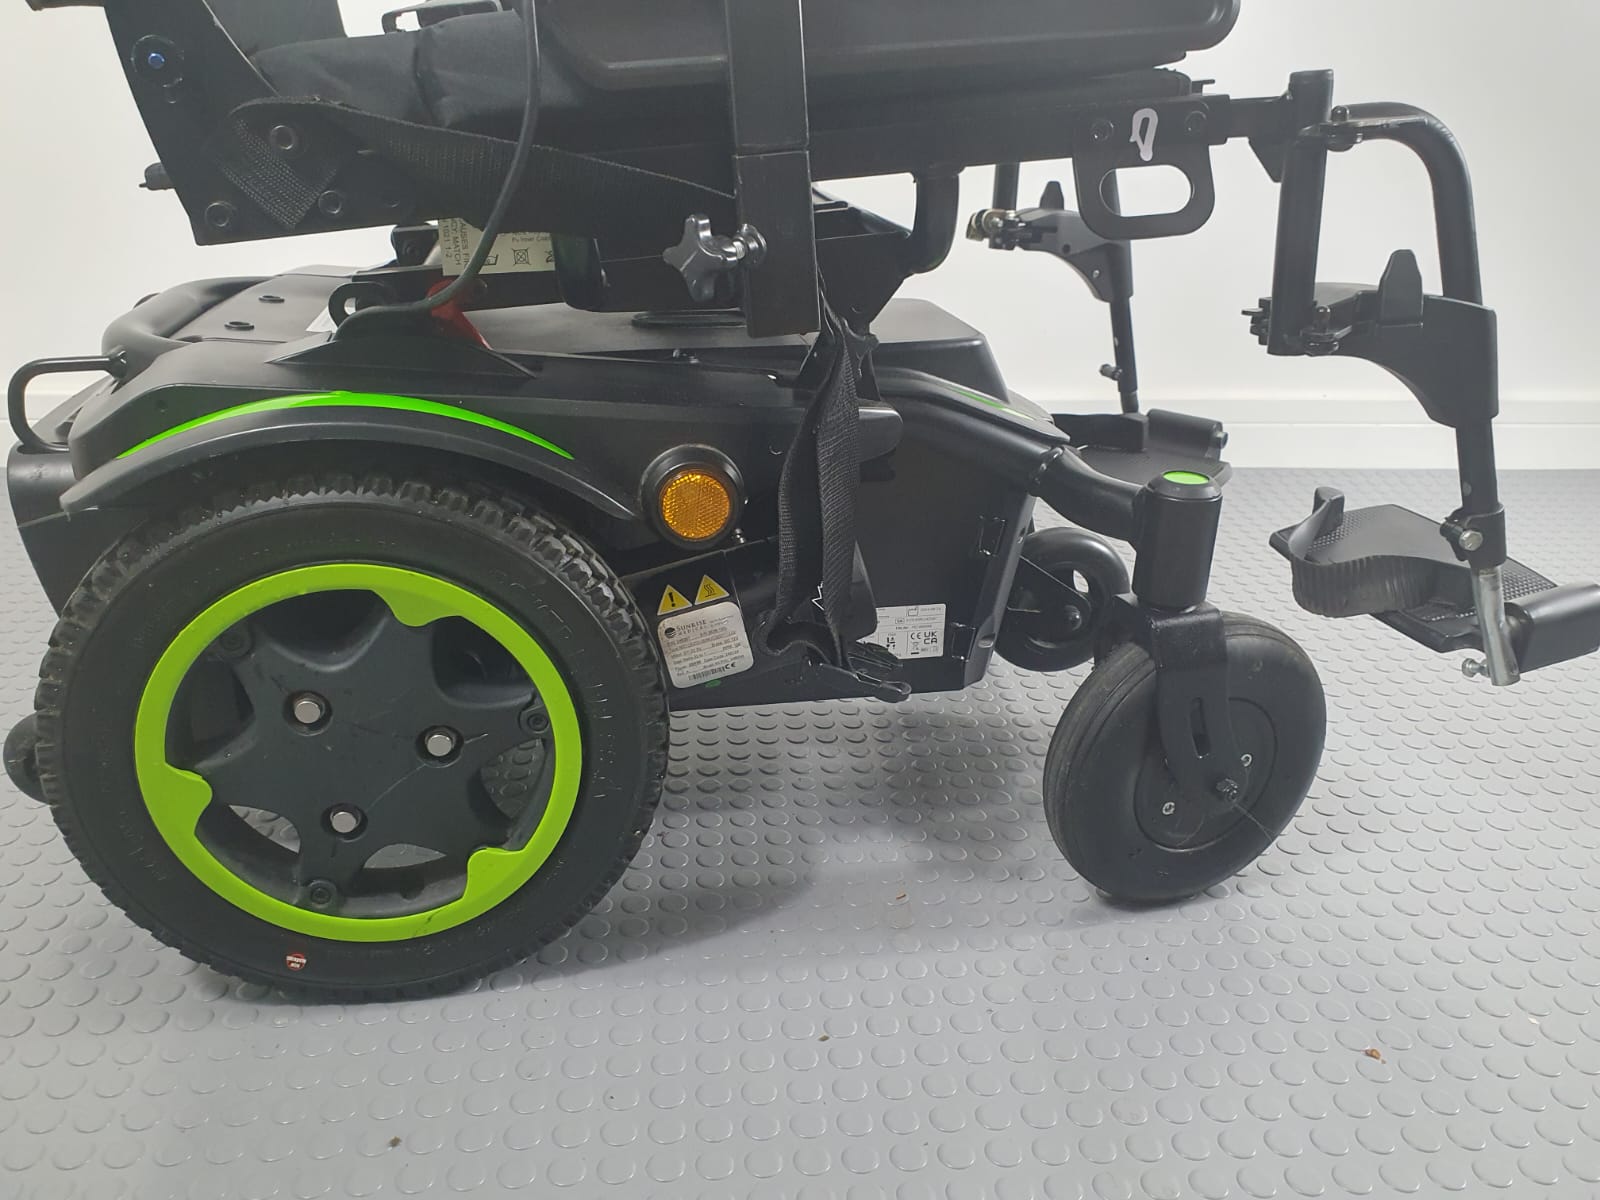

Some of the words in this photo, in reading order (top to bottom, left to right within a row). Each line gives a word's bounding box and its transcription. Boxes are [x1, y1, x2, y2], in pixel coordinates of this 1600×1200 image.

[453, 236, 462, 265] MATCH
[676, 620, 706, 631] SUNRISE
[910, 632, 921, 640] CE
